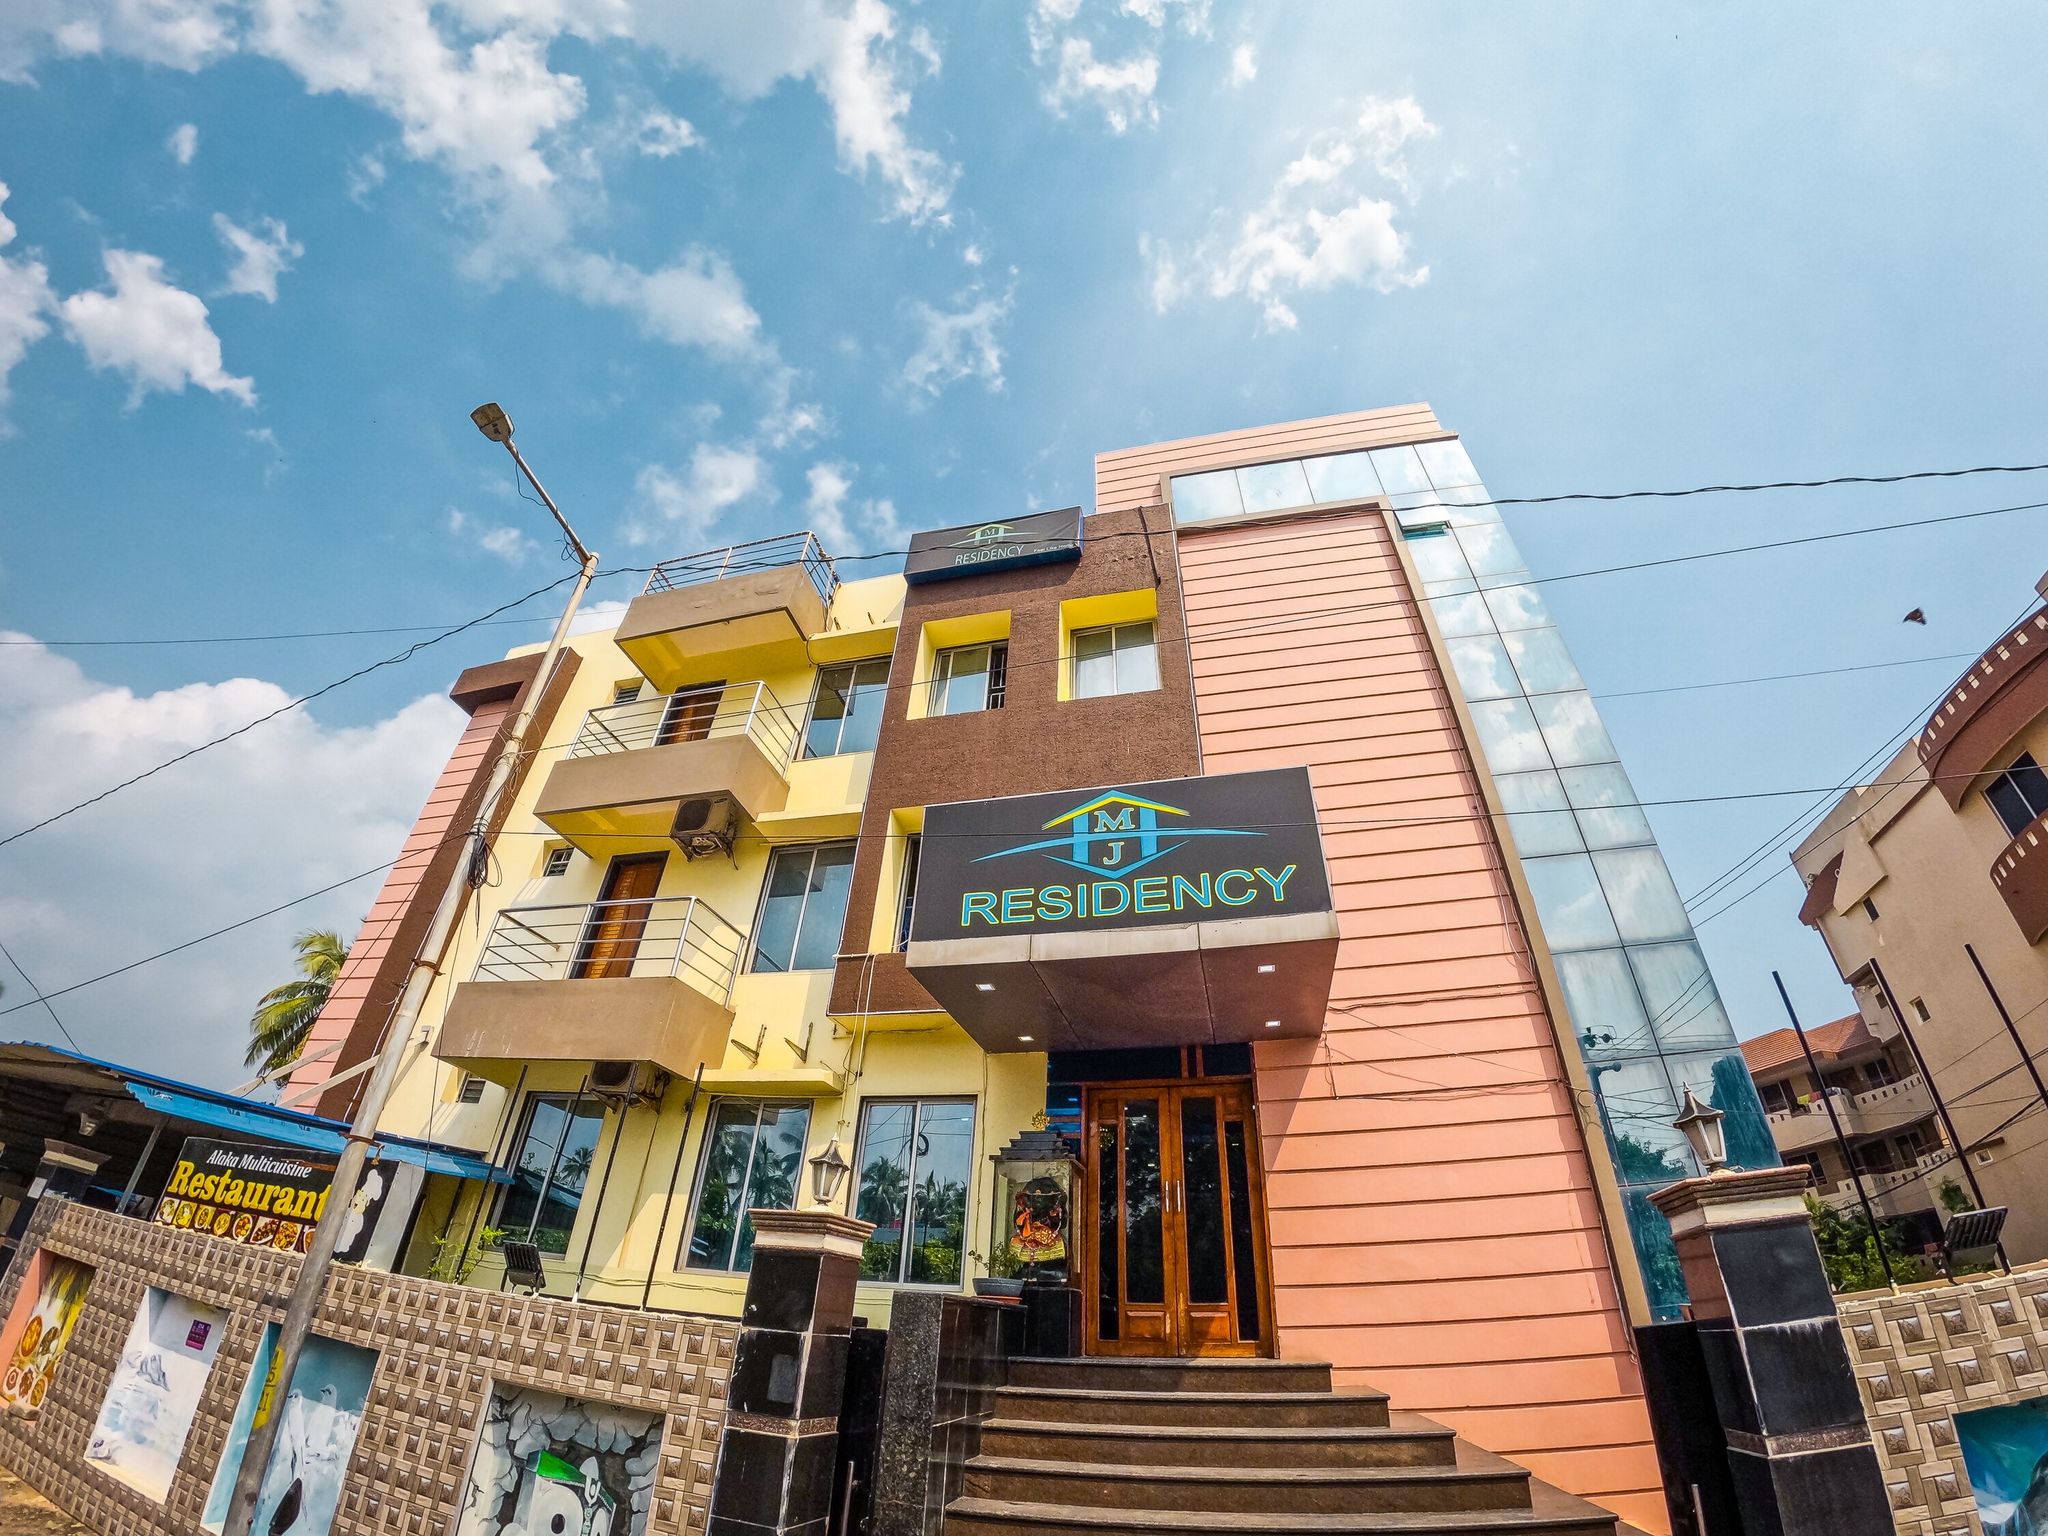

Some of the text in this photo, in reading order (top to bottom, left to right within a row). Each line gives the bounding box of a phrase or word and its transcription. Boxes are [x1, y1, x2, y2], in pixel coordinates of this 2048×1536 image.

[985, 528, 996, 536] M
[955, 544, 1025, 566] RESIDENCY
[1094, 808, 1135, 832] M
[1103, 841, 1125, 866] J
[961, 865, 1296, 926] RESIDENCY
[206, 1149, 313, 1179] Alaka Multicuisine
[167, 1160, 332, 1222] Restaurant
